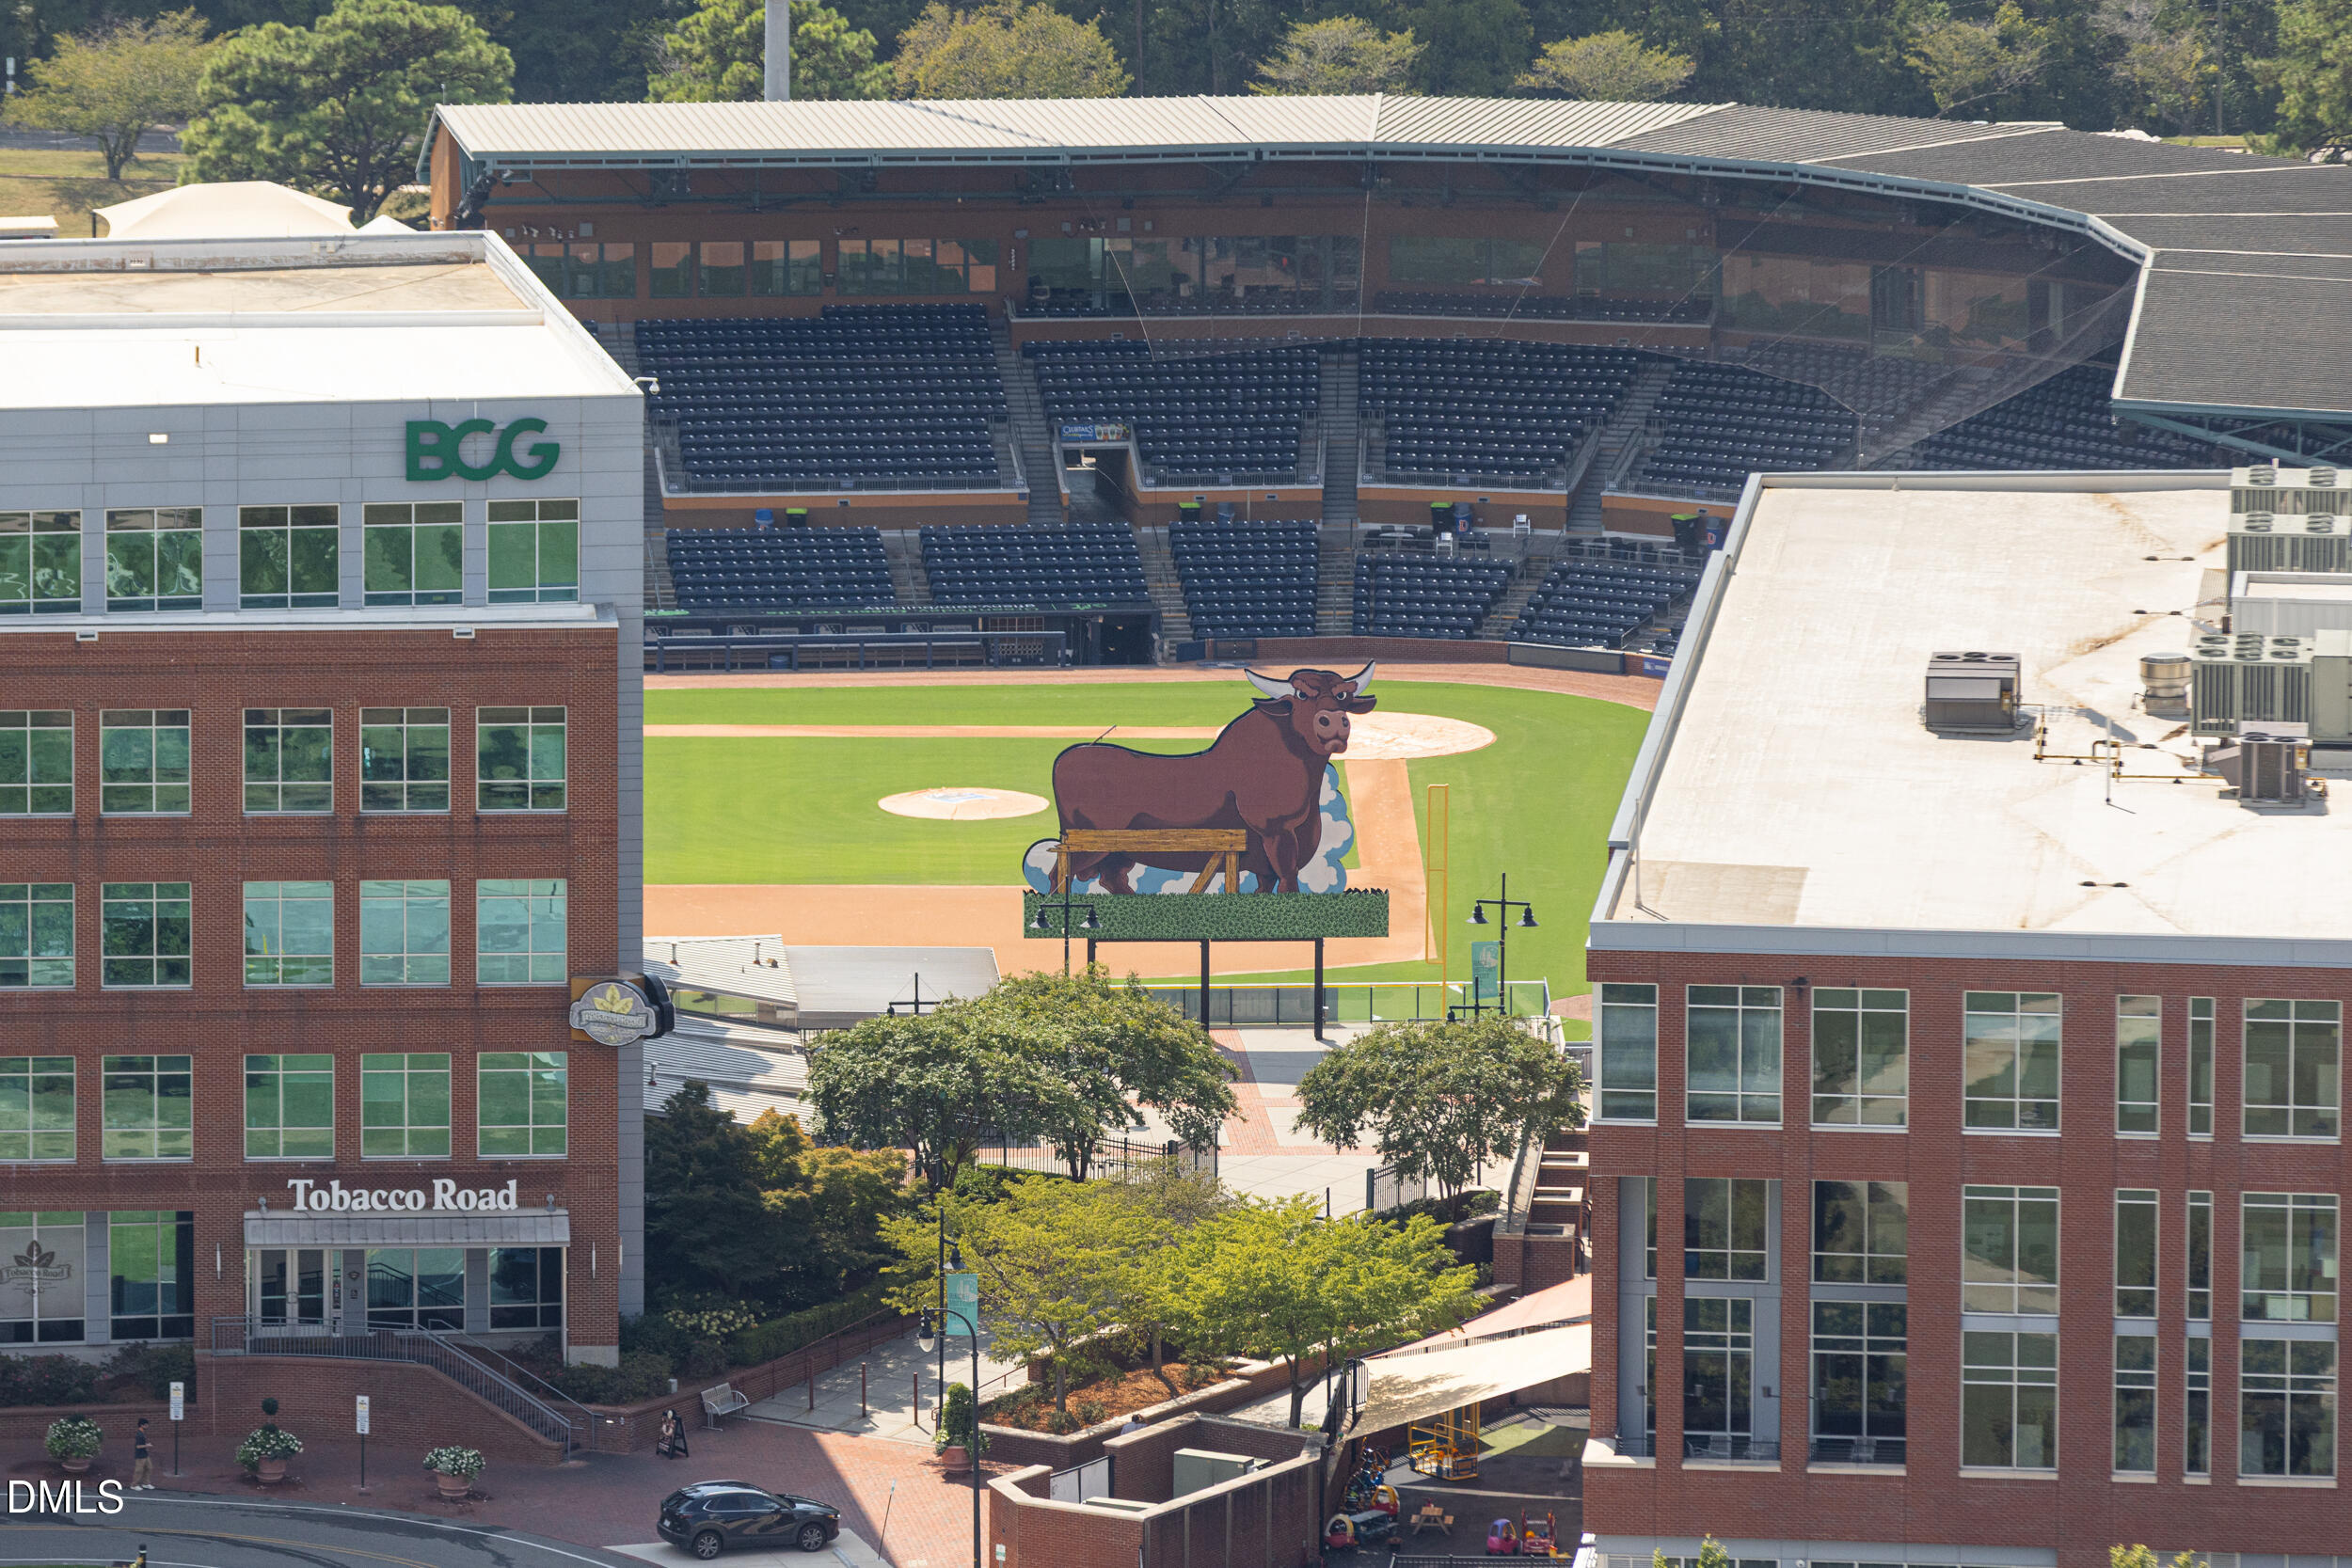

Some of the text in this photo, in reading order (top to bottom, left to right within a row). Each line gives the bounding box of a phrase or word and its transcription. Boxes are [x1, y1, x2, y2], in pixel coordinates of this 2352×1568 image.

[405, 418, 560, 482] BCG
[287, 1178, 518, 1212] Tobacco Road
